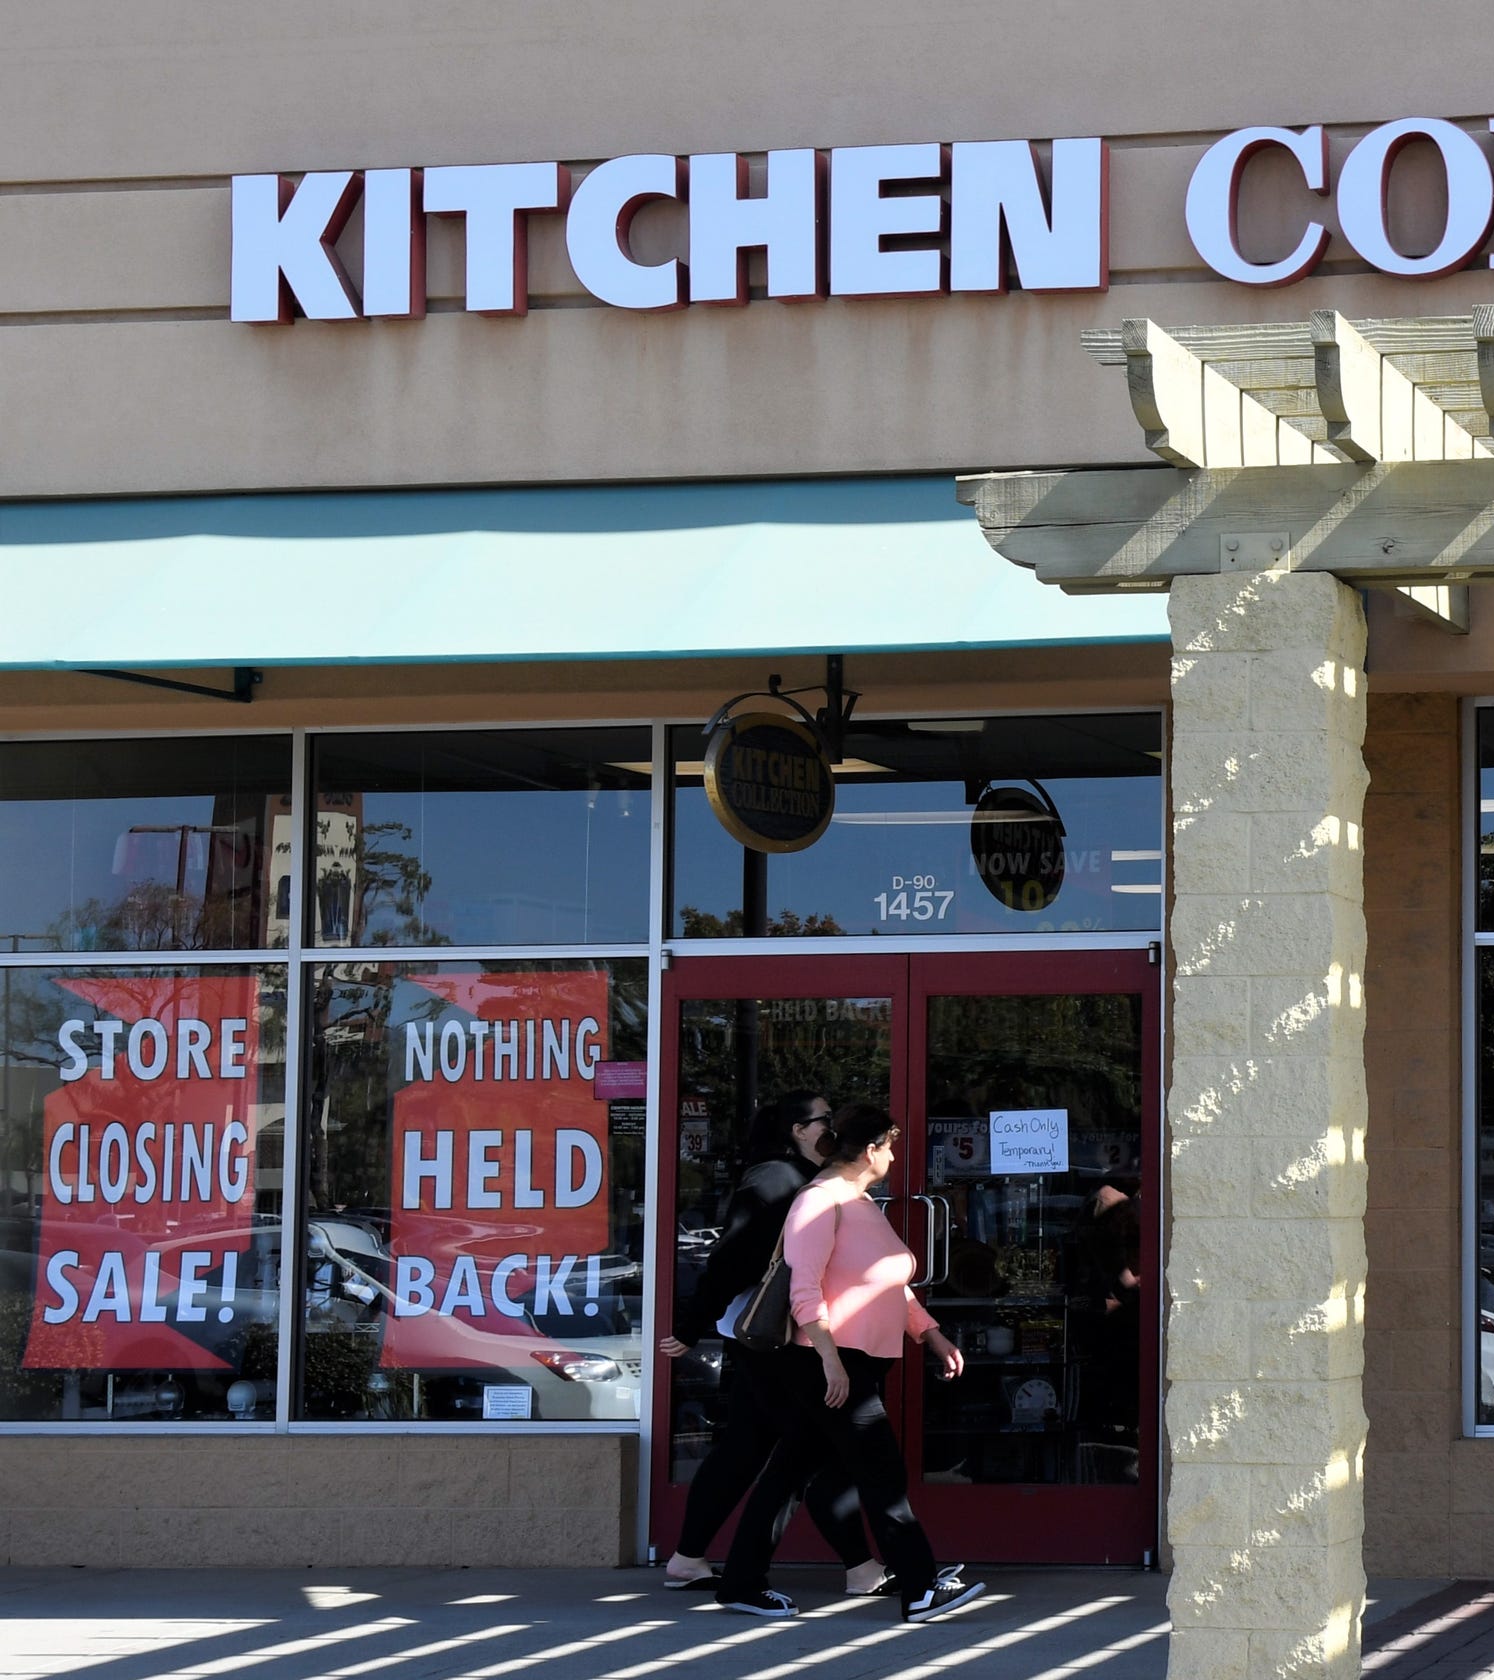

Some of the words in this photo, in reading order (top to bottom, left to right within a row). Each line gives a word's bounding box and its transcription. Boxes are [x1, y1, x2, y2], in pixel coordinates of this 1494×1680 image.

[230, 138, 1106, 325] KITCHEN
[731, 745, 821, 793] KITCHEN
[732, 780, 821, 818] COLLECTION
[969, 851, 1031, 876] NOW
[1040, 850, 1101, 875] SAVE
[892, 875, 935, 891] D-90
[873, 890, 955, 922] 1457
[58, 1017, 248, 1082] STORE
[404, 1015, 602, 1083] NOTHING
[681, 1101, 708, 1117] ALE
[975, 1119, 989, 1134] fo
[993, 1115, 1029, 1134] Cash
[1031, 1117, 1059, 1139] Only
[48, 1120, 249, 1205] CLOSING
[952, 1136, 974, 1160] $5
[999, 1142, 1055, 1162] Temporary!
[402, 1128, 604, 1210] HELD
[43, 1249, 239, 1325] SALE!
[394, 1254, 602, 1318] BACK!
